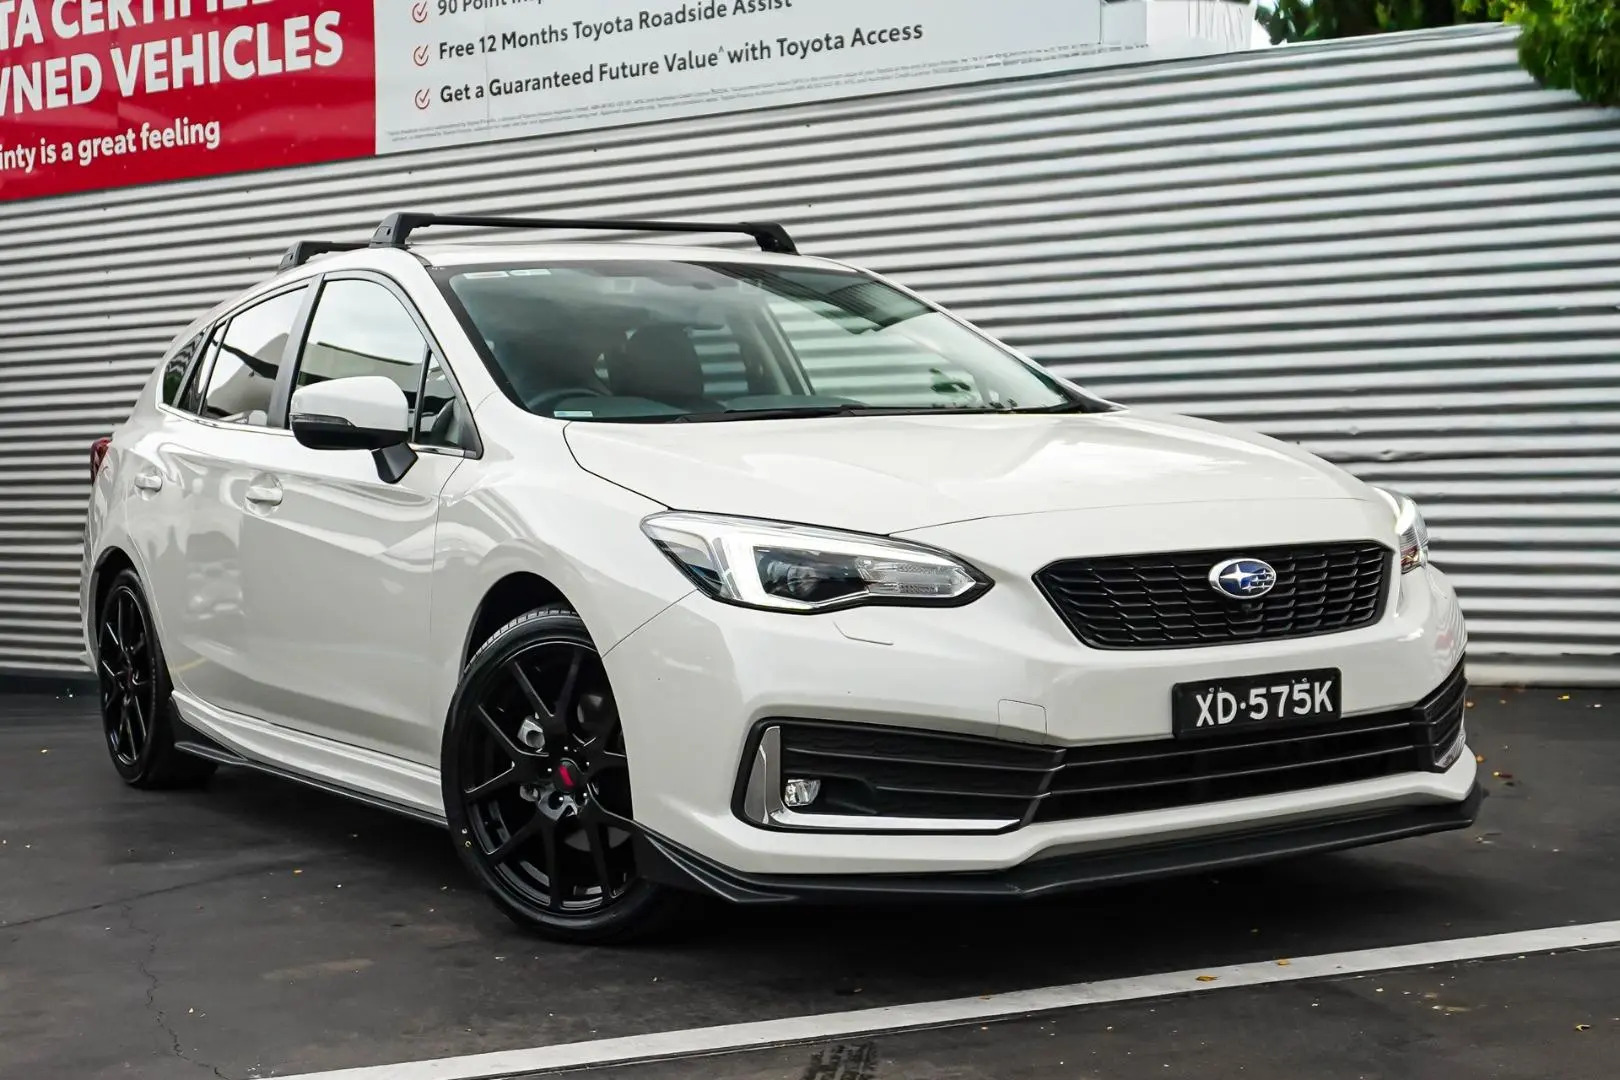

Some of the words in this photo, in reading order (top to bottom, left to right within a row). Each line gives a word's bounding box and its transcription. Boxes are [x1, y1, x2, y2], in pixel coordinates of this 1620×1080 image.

[438, 0, 458, 16] 90
[439, 42, 475, 59] Free
[479, 34, 497, 53] 12
[501, 24, 568, 50] Months
[572, 16, 633, 42] Toyota
[639, 0, 727, 29] Roadside
[732, 0, 792, 16] Assist
[110, 11, 343, 97] VEHICLES
[440, 84, 471, 103] Get
[475, 85, 484, 98] a
[489, 65, 593, 97] Guaranteed
[599, 61, 659, 82] Future
[728, 40, 771, 64] with
[776, 33, 844, 59] Toyota
[851, 24, 923, 48] Access
[40, 137, 57, 165] is
[61, 141, 73, 162] a
[78, 128, 136, 166] great
[140, 117, 220, 150] feeling
